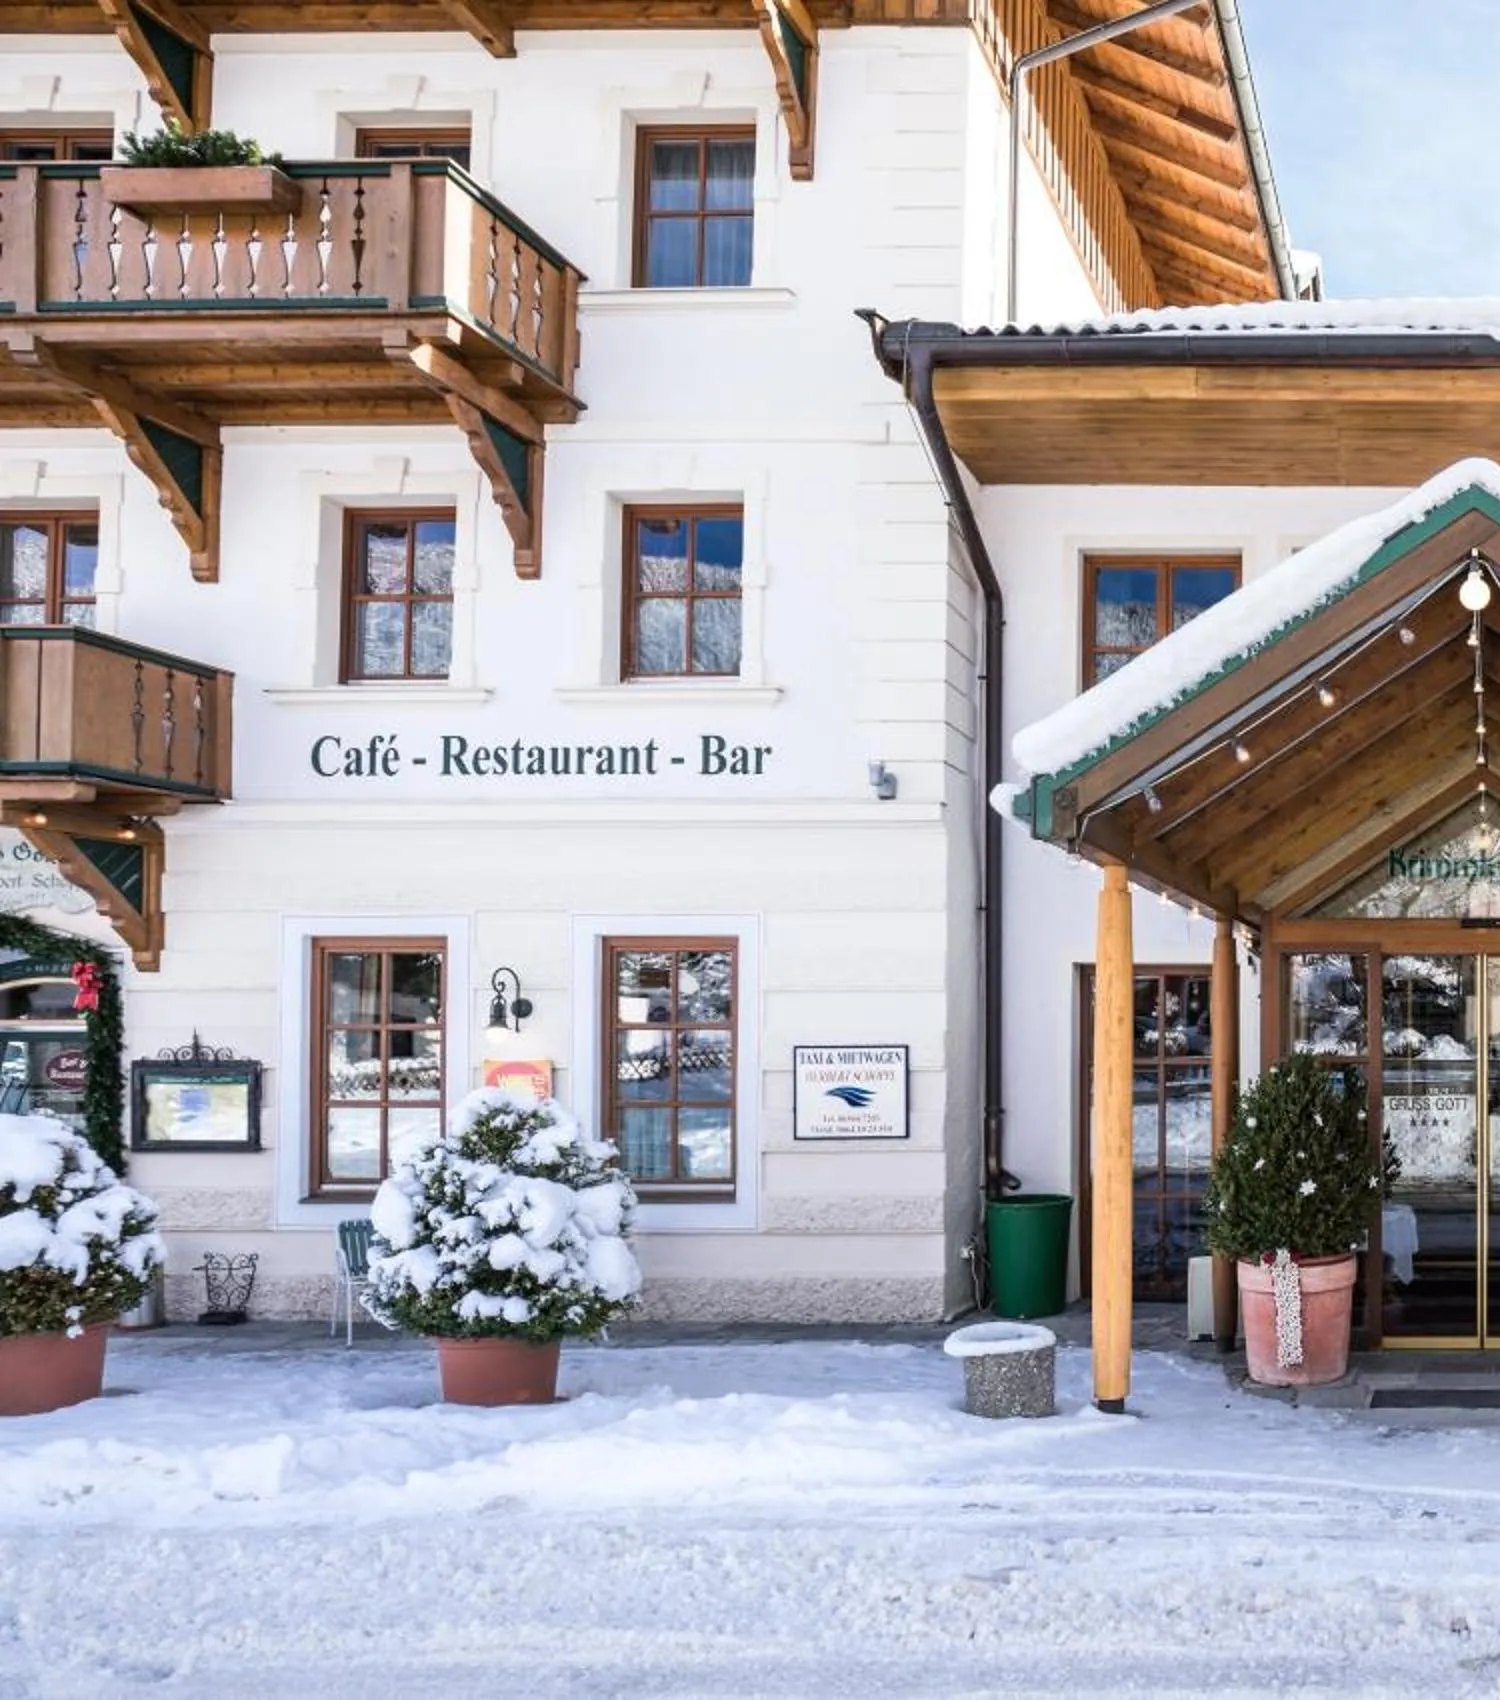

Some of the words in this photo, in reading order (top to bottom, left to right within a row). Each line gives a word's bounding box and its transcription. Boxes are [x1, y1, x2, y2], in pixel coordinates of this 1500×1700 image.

[310, 734, 401, 777] Café
[440, 734, 660, 777] Restaurant
[699, 734, 773, 776] Bar
[800, 1051, 824, 1065] TAXI
[837, 1050, 902, 1065] MIETWAGEN
[1435, 1097, 1467, 1111] GOTT
